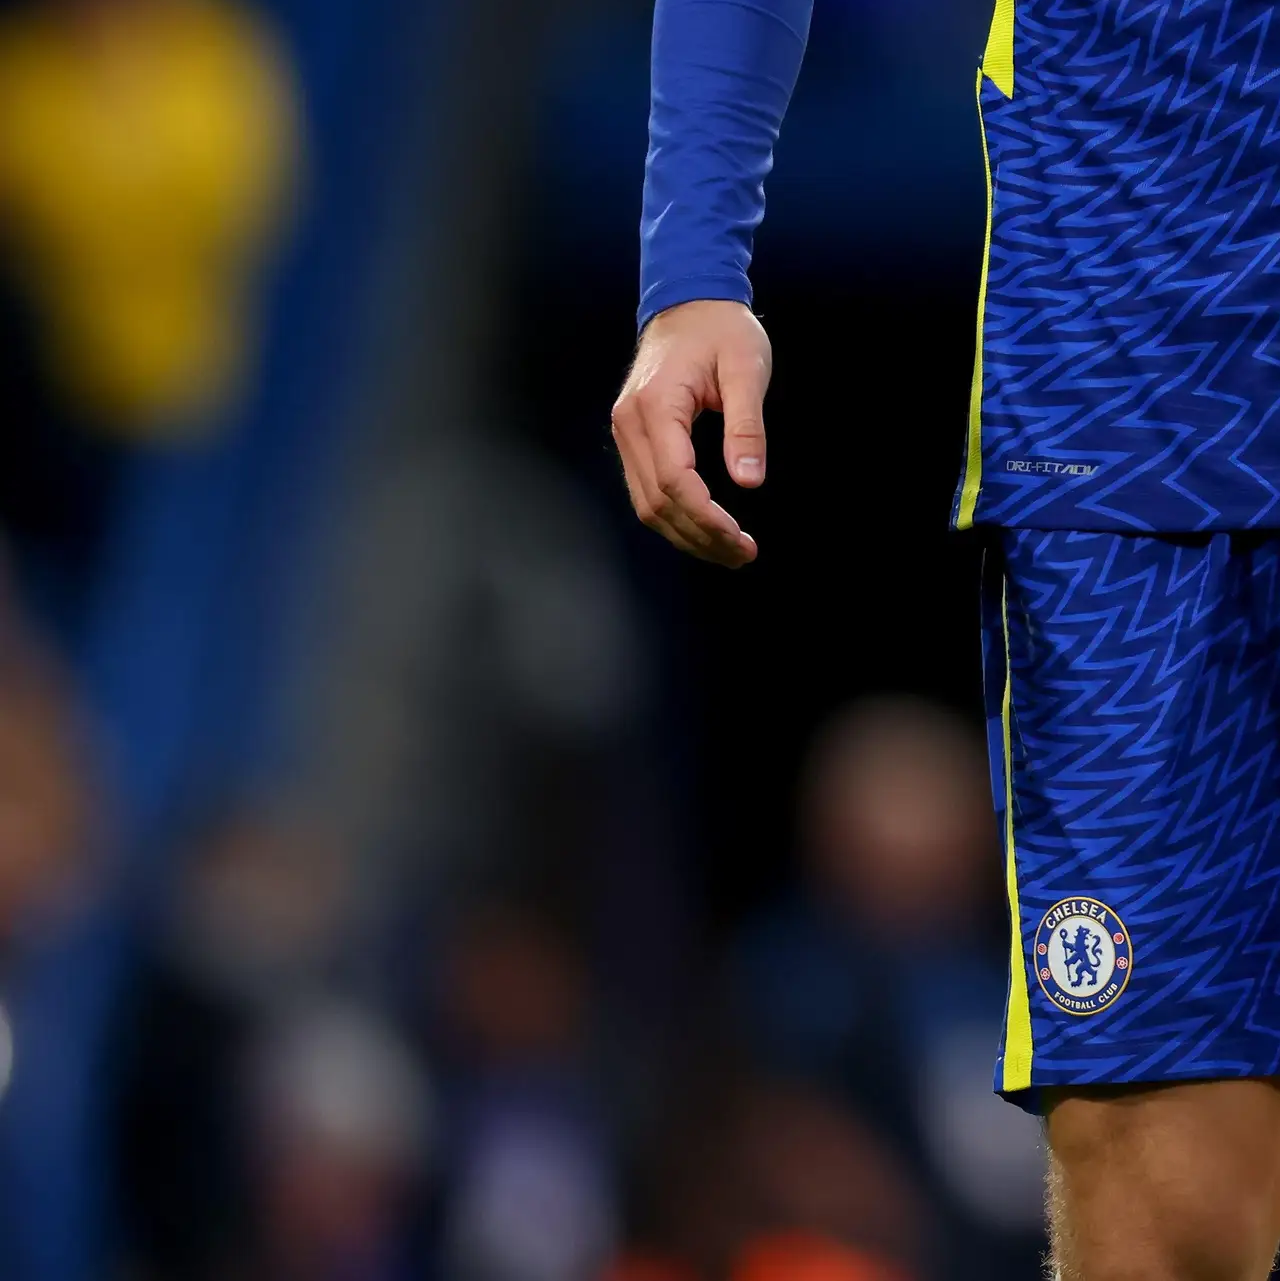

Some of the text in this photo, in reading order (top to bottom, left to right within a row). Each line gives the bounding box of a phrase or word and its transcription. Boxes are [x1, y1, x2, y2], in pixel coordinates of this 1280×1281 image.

[1045, 901, 1107, 929] CHELSEA
[1054, 982, 1118, 1010] FOOTBALL CLUB
